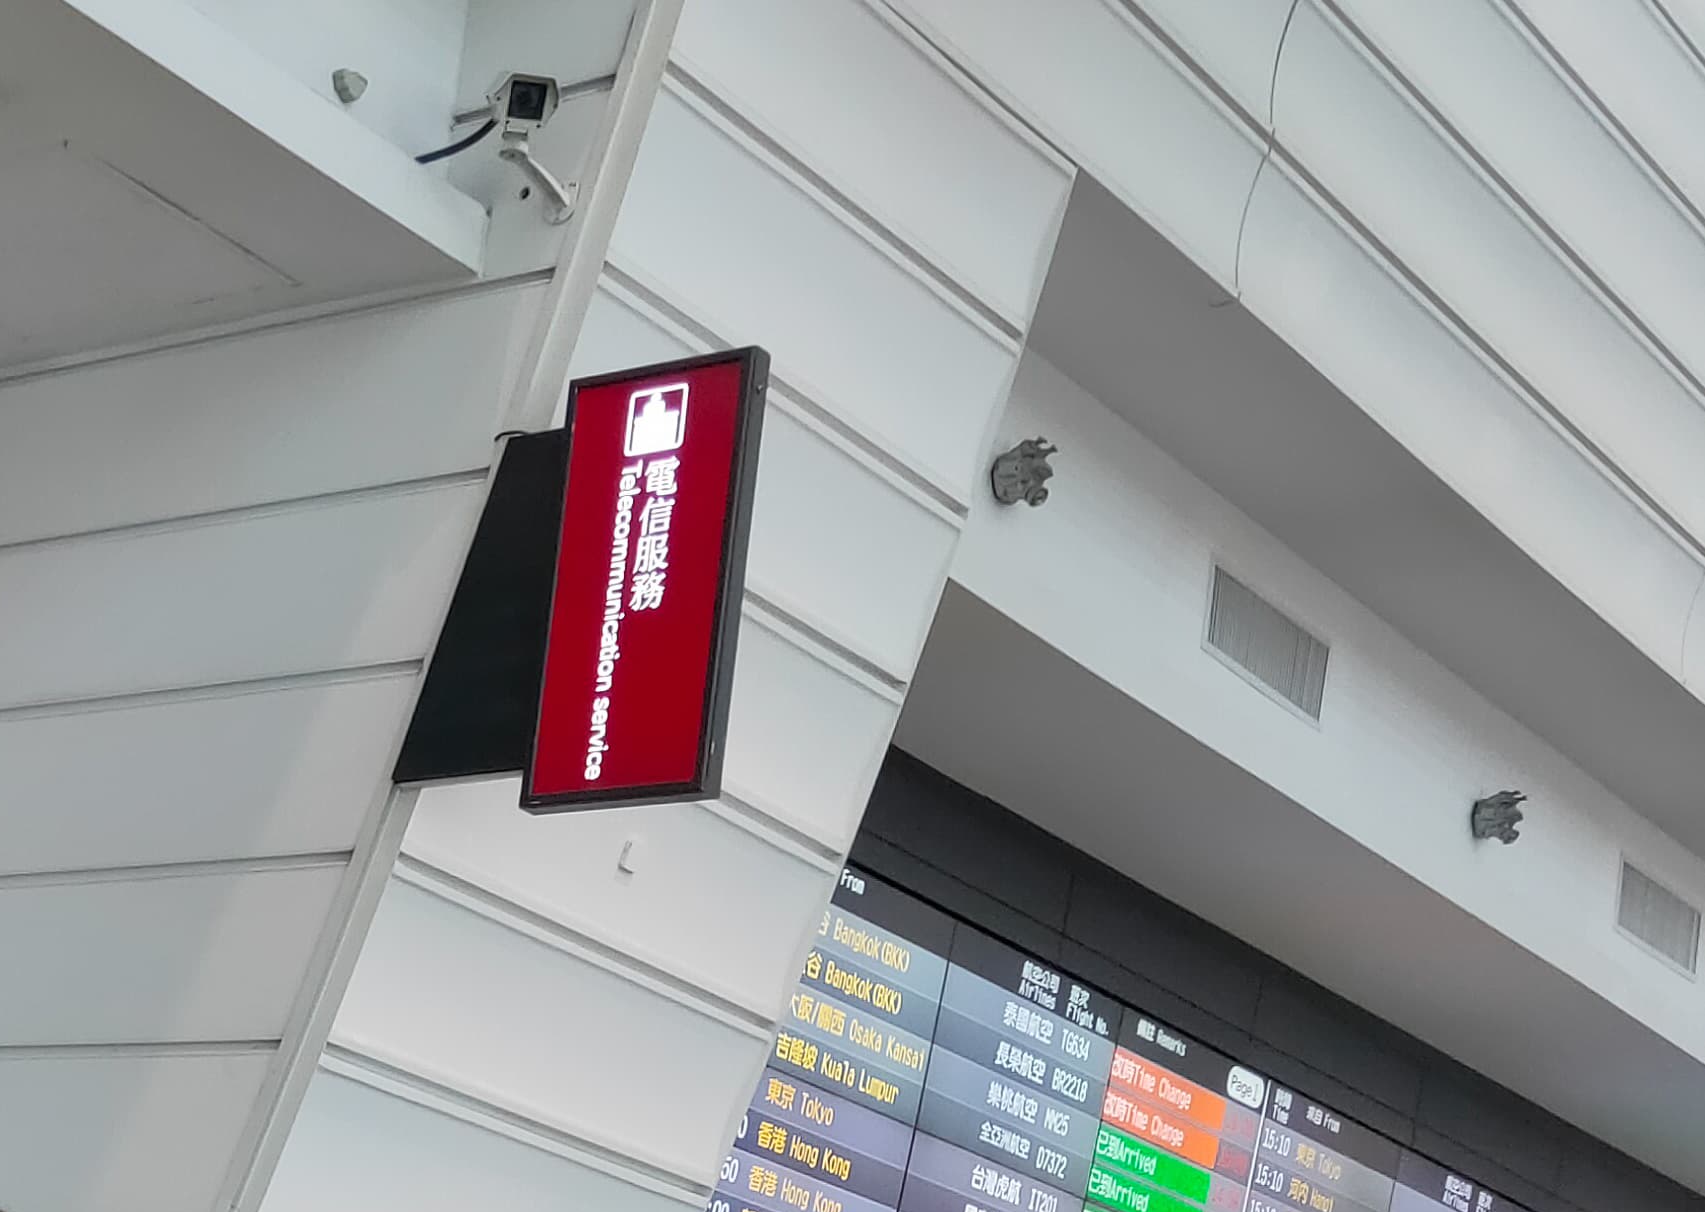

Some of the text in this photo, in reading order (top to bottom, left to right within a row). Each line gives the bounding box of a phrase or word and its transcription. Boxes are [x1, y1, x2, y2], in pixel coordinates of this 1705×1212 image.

[629, 456, 681, 612] 電信服務
[584, 460, 643, 781] Telecommunication service
[840, 869, 865, 896] From
[849, 1018, 882, 1052] Osaka
[886, 1036, 924, 1073] Kansai
[1061, 1028, 1091, 1061] TG634
[776, 1032, 899, 1105] 吉隆坡 Kuala Lumpur
[765, 1078, 834, 1126] 東京 Tokyo
[1158, 1077, 1192, 1111] Change
[758, 1121, 787, 1155] 香港
[789, 1135, 818, 1168] Hong
[822, 1148, 851, 1181] Kong
[1151, 1115, 1184, 1148] Change
[1262, 1127, 1290, 1157] 15:10
[1036, 1145, 1067, 1179] D7372
[1255, 1163, 1284, 1192] 15:10
[749, 1165, 778, 1198] 香港
[781, 1178, 810, 1211] Hong
[971, 1164, 1022, 1206] 台灣虎航
